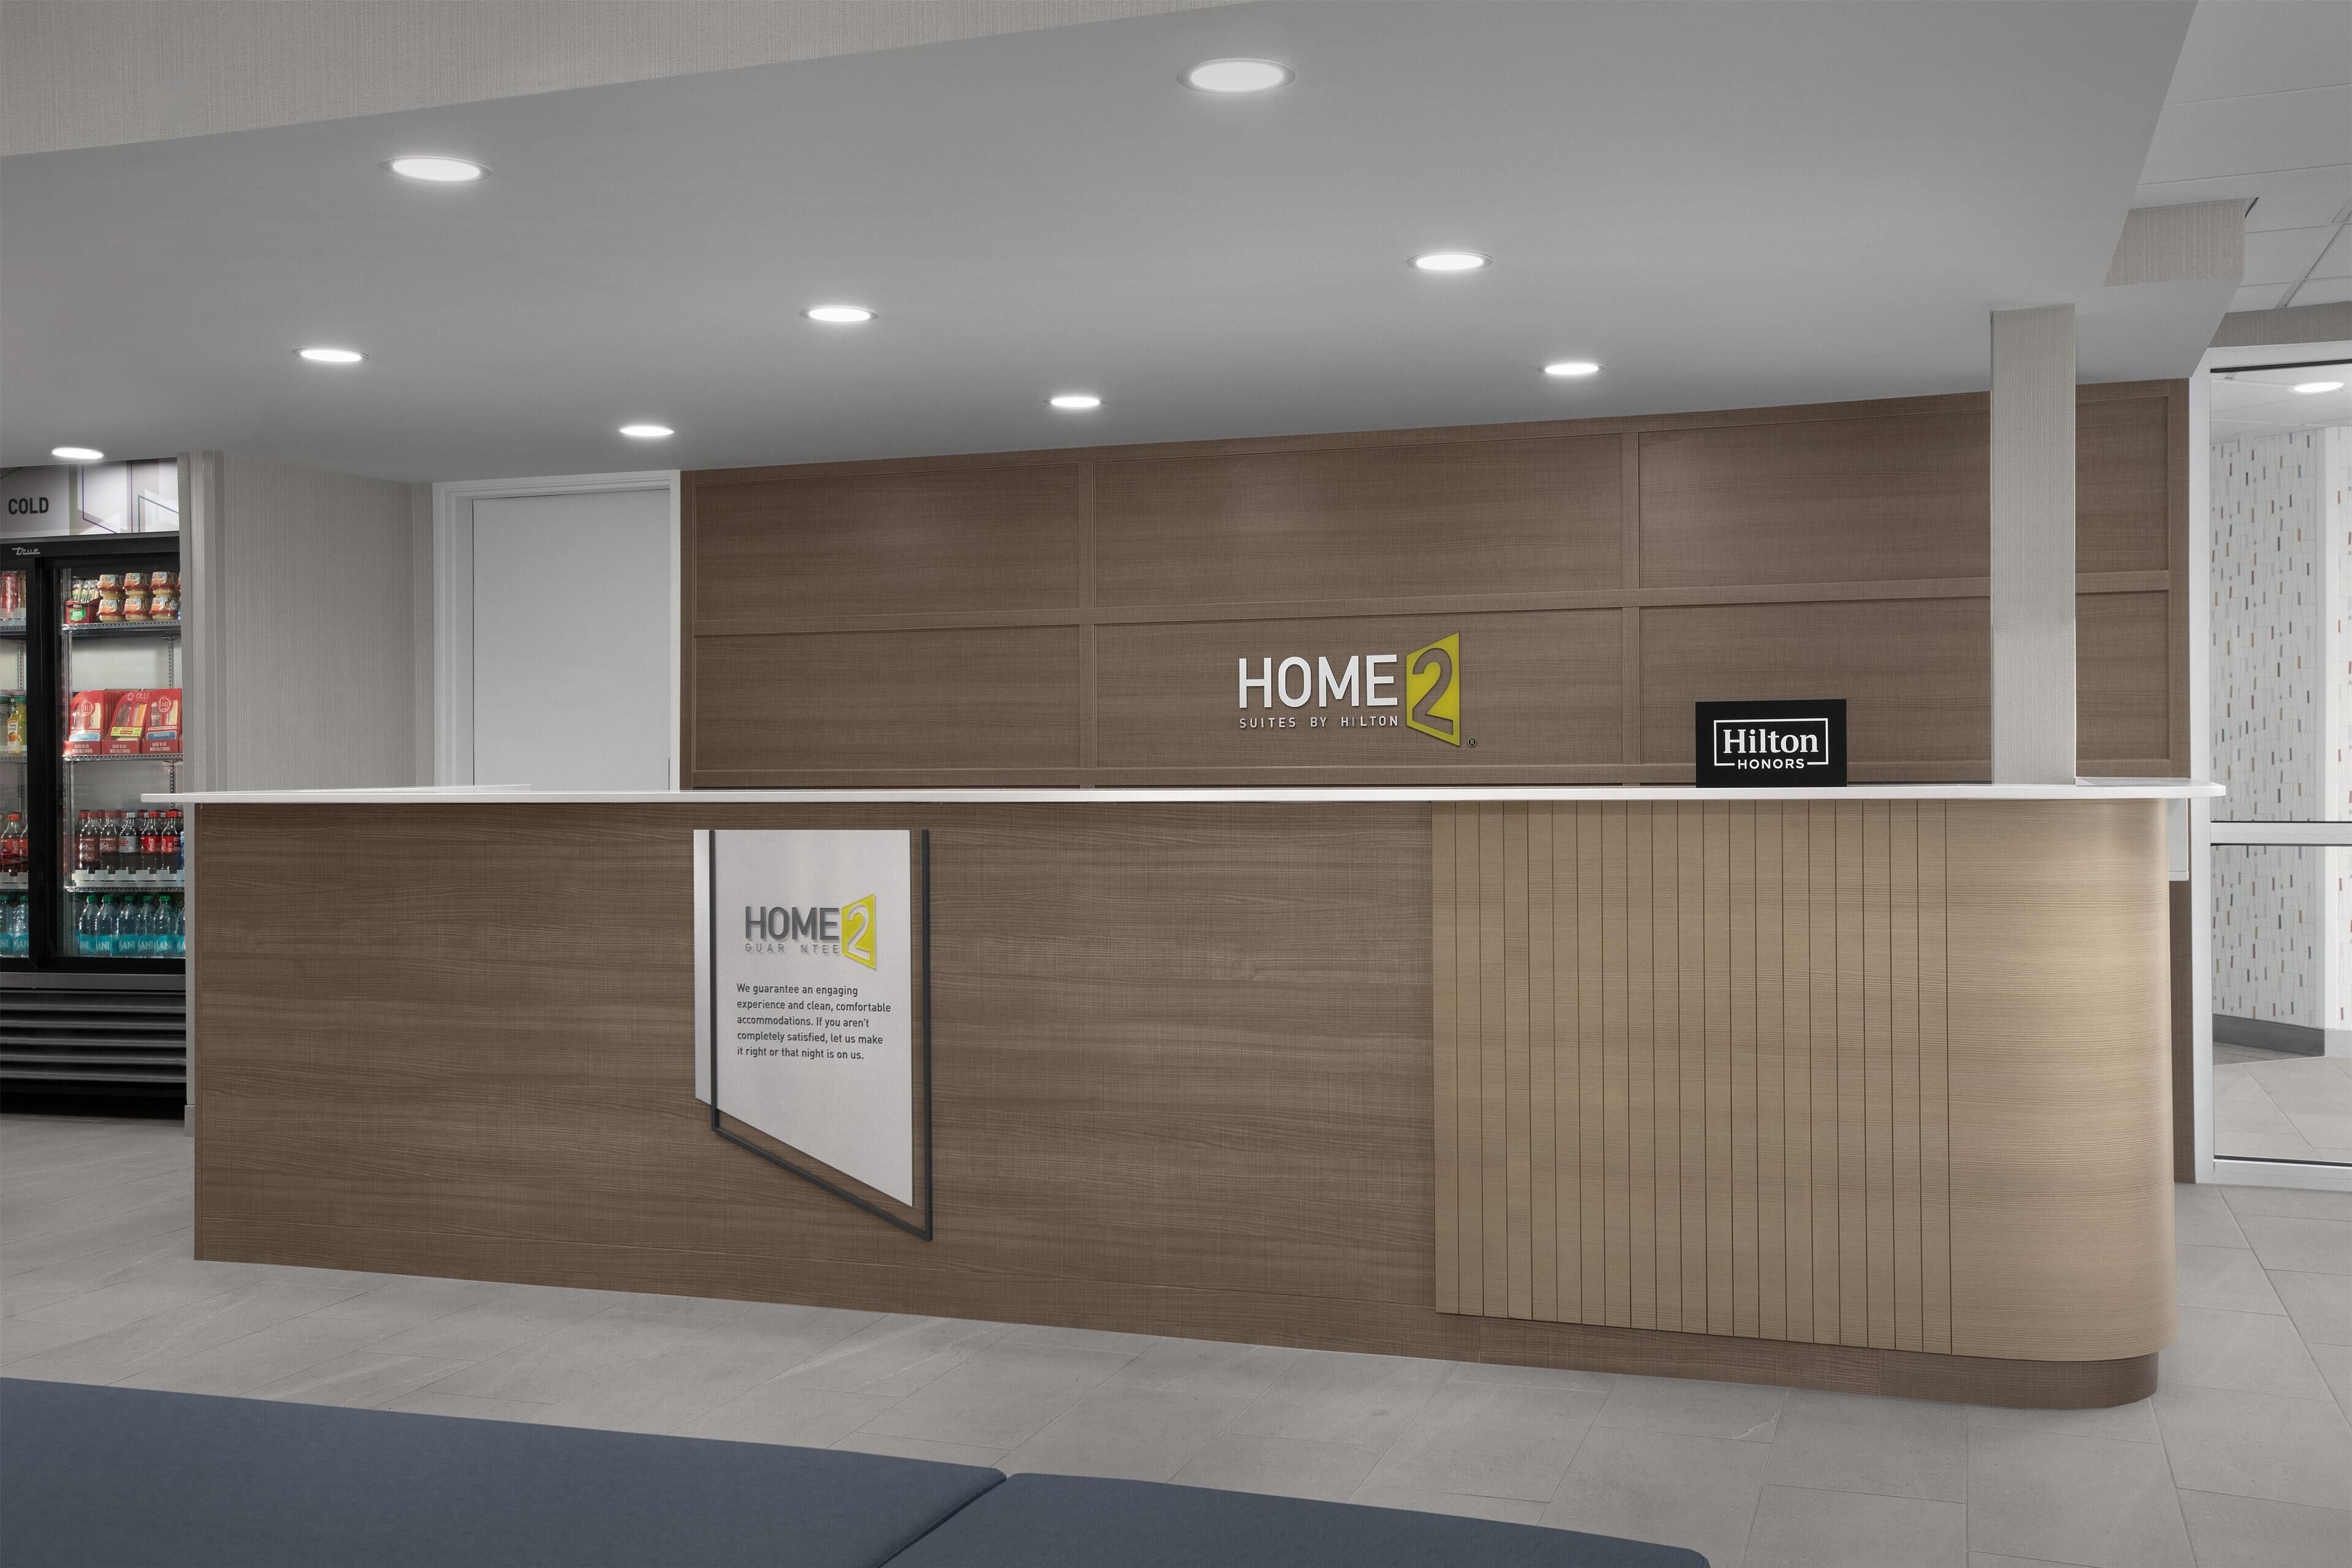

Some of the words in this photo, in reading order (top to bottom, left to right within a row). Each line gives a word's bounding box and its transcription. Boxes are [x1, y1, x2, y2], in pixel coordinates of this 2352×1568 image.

[8, 497, 49, 514] COLD
[1239, 717, 1296, 728] SUITES
[1310, 717, 1327, 728] BY
[1341, 715, 1398, 727] HILTON
[1723, 729, 1819, 753] Hilton
[1738, 758, 1804, 769] HONORS
[119, 939, 135, 951] SANI
[138, 939, 153, 951] SANI
[737, 983, 750, 992] We
[753, 985, 799, 995] guarantee
[816, 986, 858, 997] engaging
[737, 1000, 785, 1010] experience
[788, 1000, 804, 1009] and
[807, 1001, 833, 1012] clean,
[836, 1002, 891, 1012] comfortable
[737, 1016, 813, 1026] accommodations.
[816, 1017, 822, 1026] If
[824, 1019, 840, 1028] you
[843, 1018, 869, 1027] aren't
[737, 1031, 785, 1042] completely
[787, 1032, 827, 1044] satisfied,
[831, 1033, 842, 1042] let
[858, 1035, 883, 1044] make
[737, 1046, 743, 1055] it
[746, 1047, 767, 1058] right
[782, 1047, 799, 1057] that
[802, 1049, 824, 1060] night
[827, 1049, 834, 1058] is
